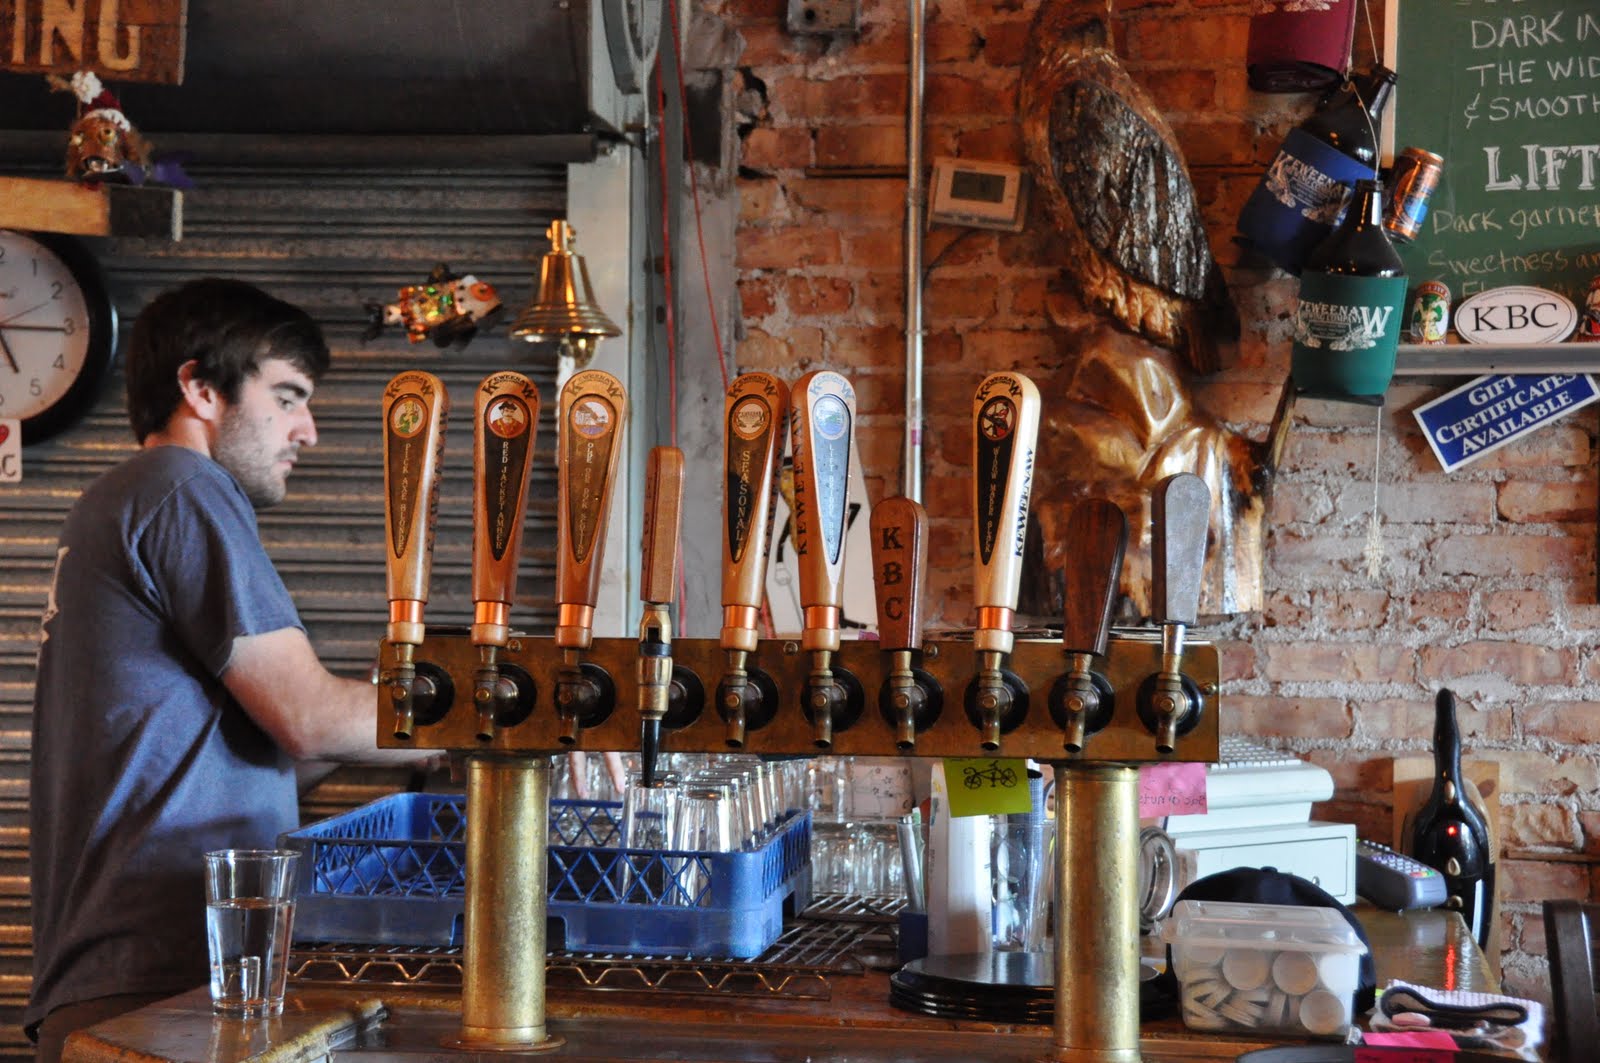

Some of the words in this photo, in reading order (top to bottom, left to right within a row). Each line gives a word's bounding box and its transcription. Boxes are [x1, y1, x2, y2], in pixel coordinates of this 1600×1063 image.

[1472, 10, 1564, 48] DARK
[1466, 60, 1535, 87] THE
[1464, 92, 1480, 129] &
[1483, 144, 1600, 191] LIFT
[1433, 208, 1503, 235] Dark
[1428, 250, 1569, 276] Sweetness
[1470, 302, 1559, 332] KBC
[1468, 375, 1517, 406] GIFT
[1435, 372, 1577, 444] CERTIFICATES
[1462, 391, 1573, 456] AVAILABLE
[501, 441, 509, 464] RED
[735, 450, 751, 541] SEASONAL
